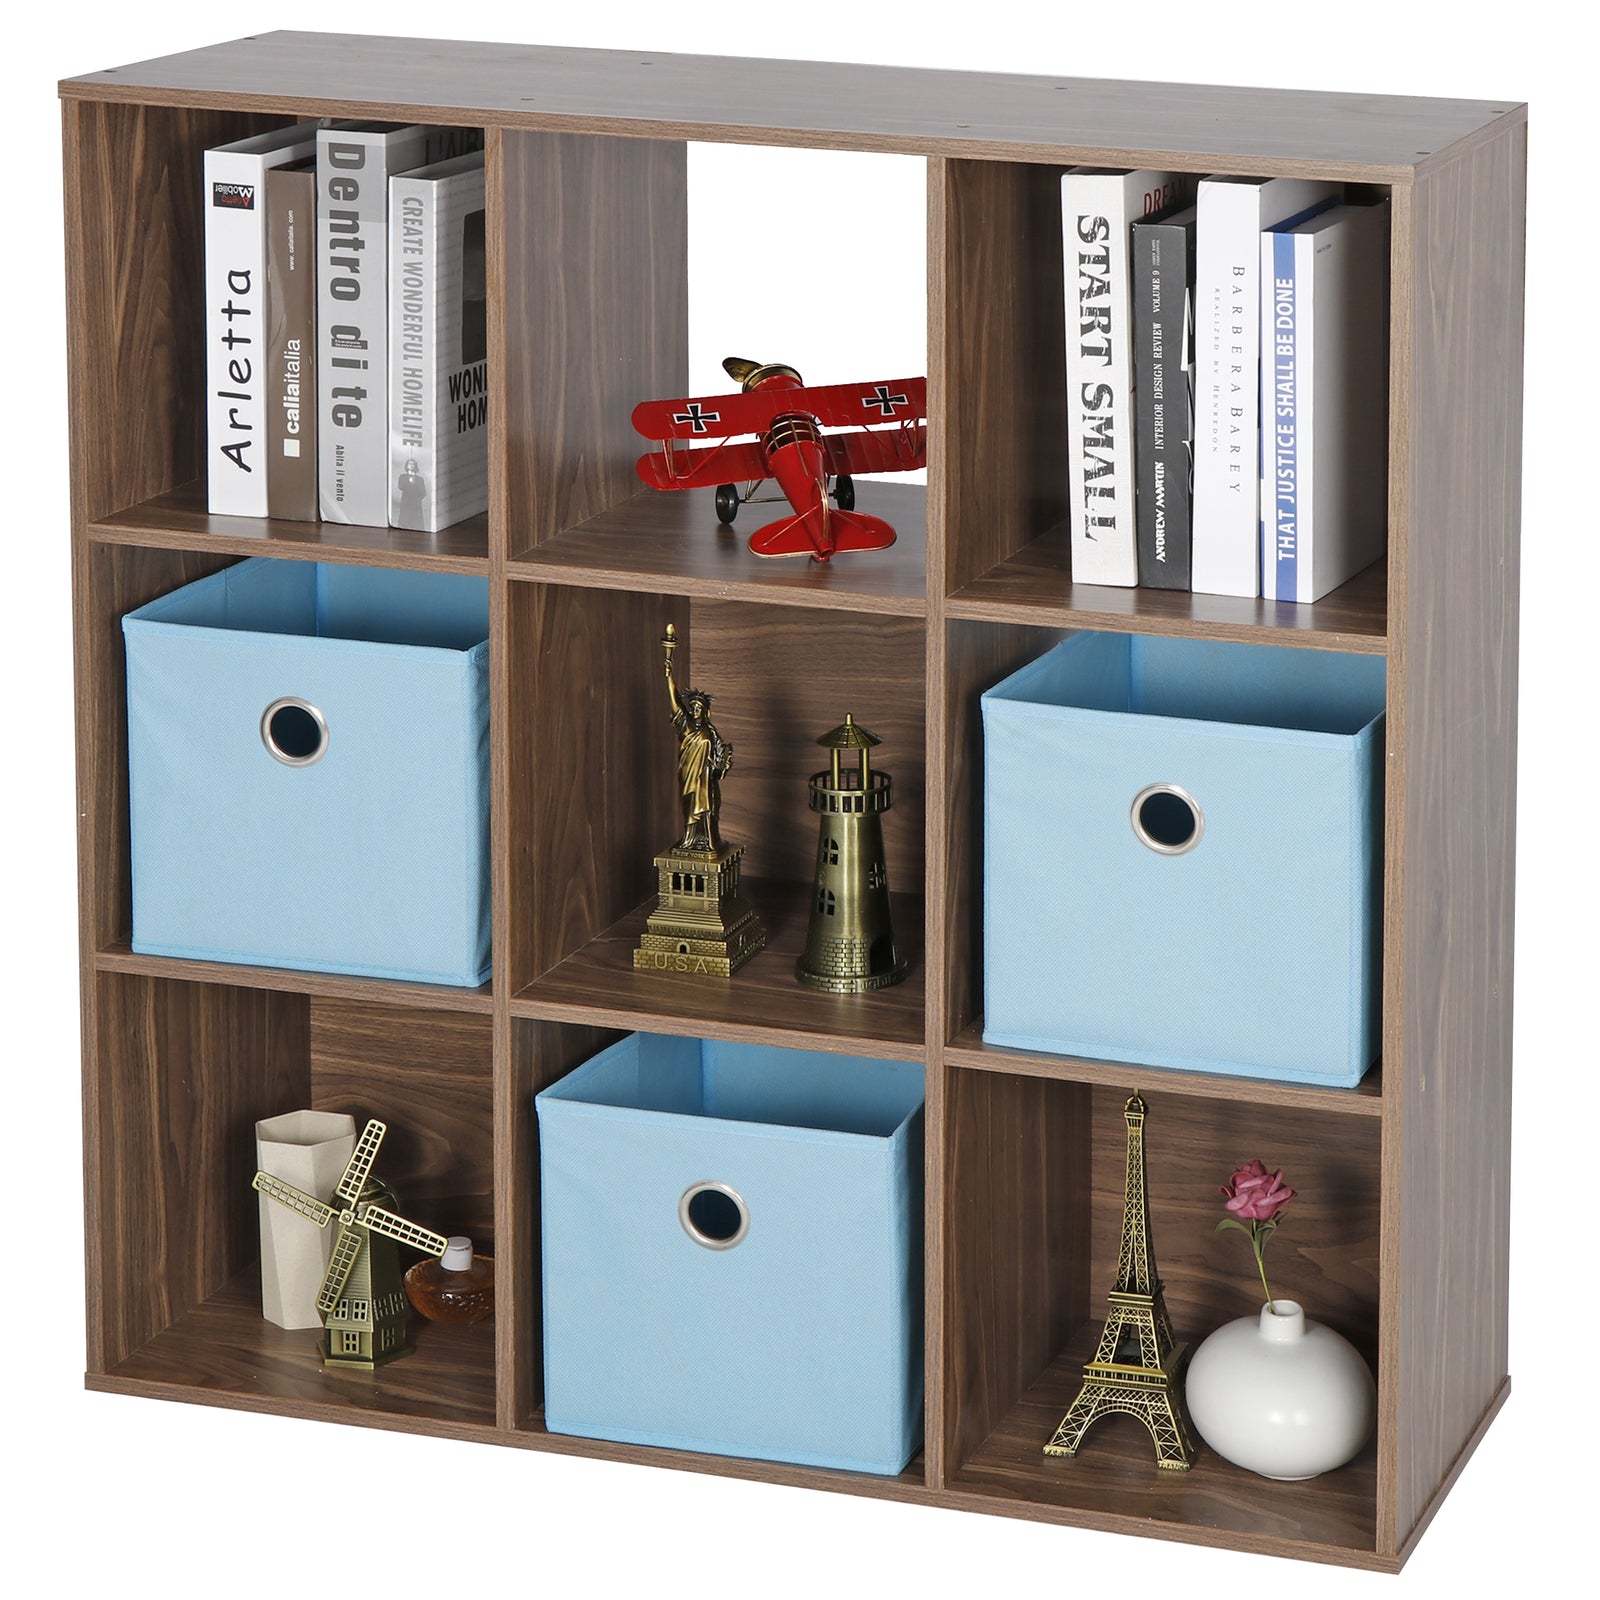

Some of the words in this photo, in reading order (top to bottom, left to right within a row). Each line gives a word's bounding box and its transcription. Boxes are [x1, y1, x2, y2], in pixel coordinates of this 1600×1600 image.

[215, 184, 253, 198] Mobilier
[328, 142, 366, 302] Dentro
[402, 197, 424, 255] CREATE
[402, 262, 424, 361] WONDERFUL
[1076, 214, 1113, 367] START
[1152, 277, 1162, 314] VOLUME
[1275, 278, 1294, 331] DONE
[1153, 321, 1163, 359] REVIEW
[1213, 288, 1221, 351] REALIZED
[1276, 335, 1294, 354] BE
[217, 269, 253, 473] Arletta
[330, 324, 368, 370] di
[1212, 360, 1220, 374] BY
[283, 339, 301, 434] caliaitalia
[331, 385, 367, 428] te
[1153, 361, 1163, 399] DESIGN
[1276, 359, 1295, 418] SHALL
[402, 367, 424, 448] HOMELIFE
[1154, 403, 1164, 450] INTERIOR
[1212, 385, 1220, 453] HENREDON
[1081, 382, 1117, 542] SMALL
[1155, 461, 1165, 508] MARTIN
[1277, 424, 1296, 503] JUSTICE
[1155, 509, 1166, 563] ANDREW
[1277, 509, 1296, 561] THAT
